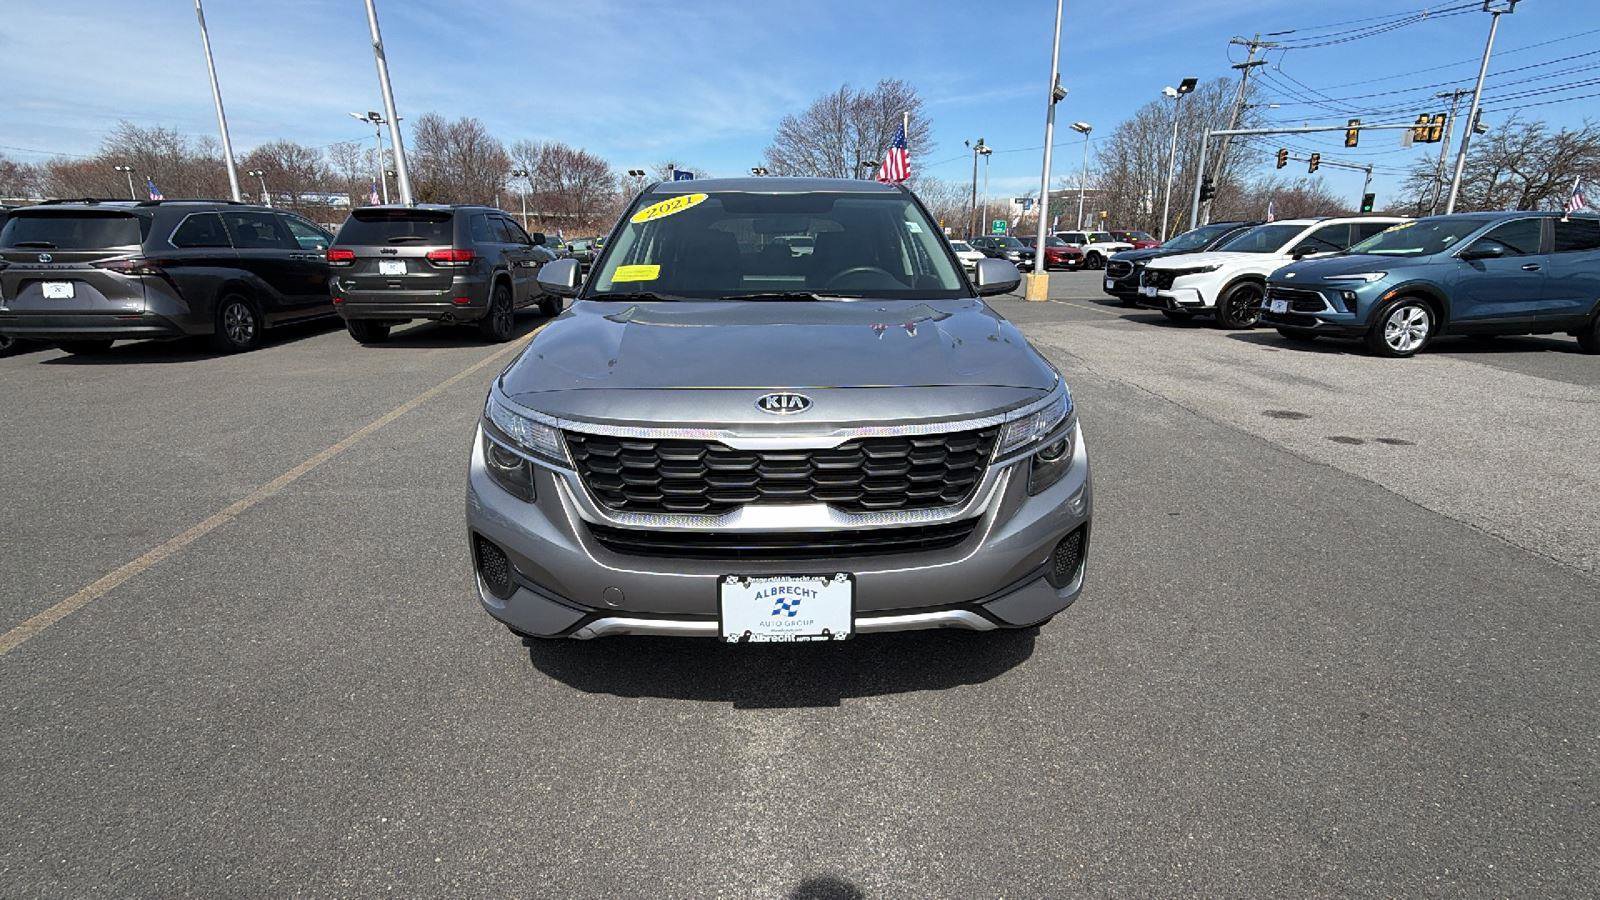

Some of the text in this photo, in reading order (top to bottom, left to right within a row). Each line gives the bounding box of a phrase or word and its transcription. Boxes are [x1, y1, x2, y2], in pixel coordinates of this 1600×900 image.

[646, 196, 692, 219] 2021
[380, 247, 398, 255] Jeep
[766, 396, 803, 408] KIA
[754, 586, 818, 601] ALBRECHT
[785, 619, 814, 627] GROUP
[748, 633, 796, 643] Albrecht
